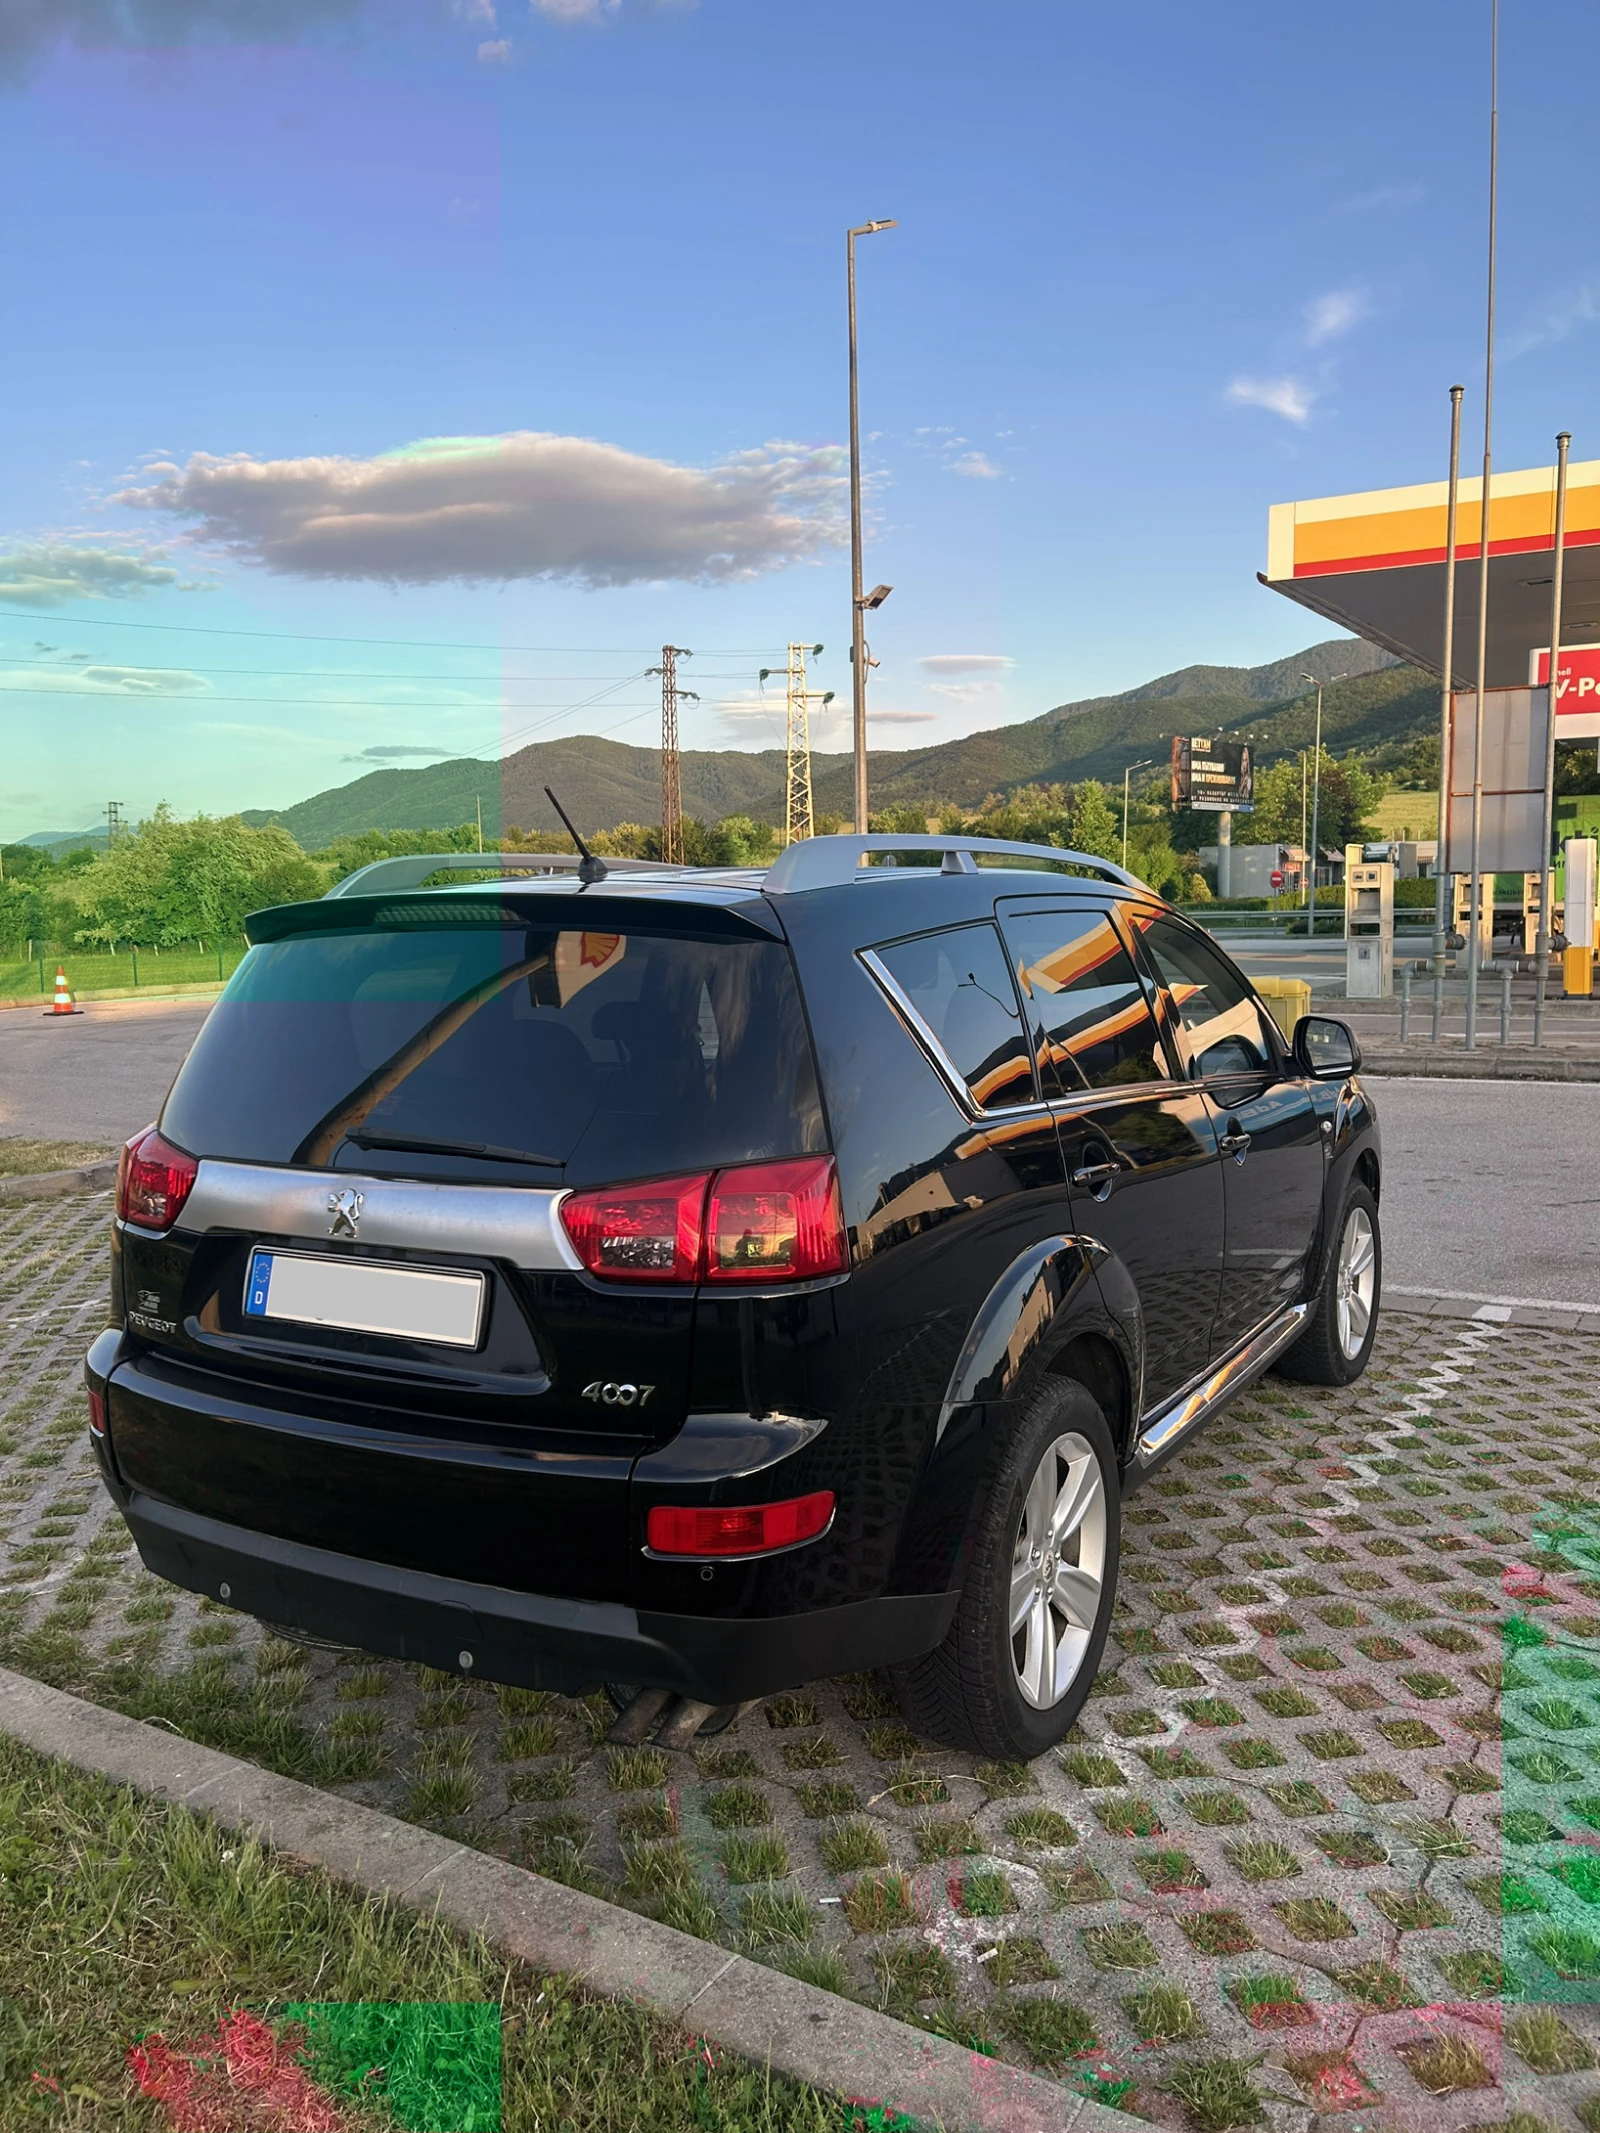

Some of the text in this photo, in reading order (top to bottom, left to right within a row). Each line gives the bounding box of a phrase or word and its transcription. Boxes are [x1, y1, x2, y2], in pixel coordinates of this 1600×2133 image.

[1557, 667, 1572, 676] ell
[254, 1290, 264, 1304] D
[128, 1310, 177, 1334] PEUGEOT
[581, 1381, 656, 1406] 4007
